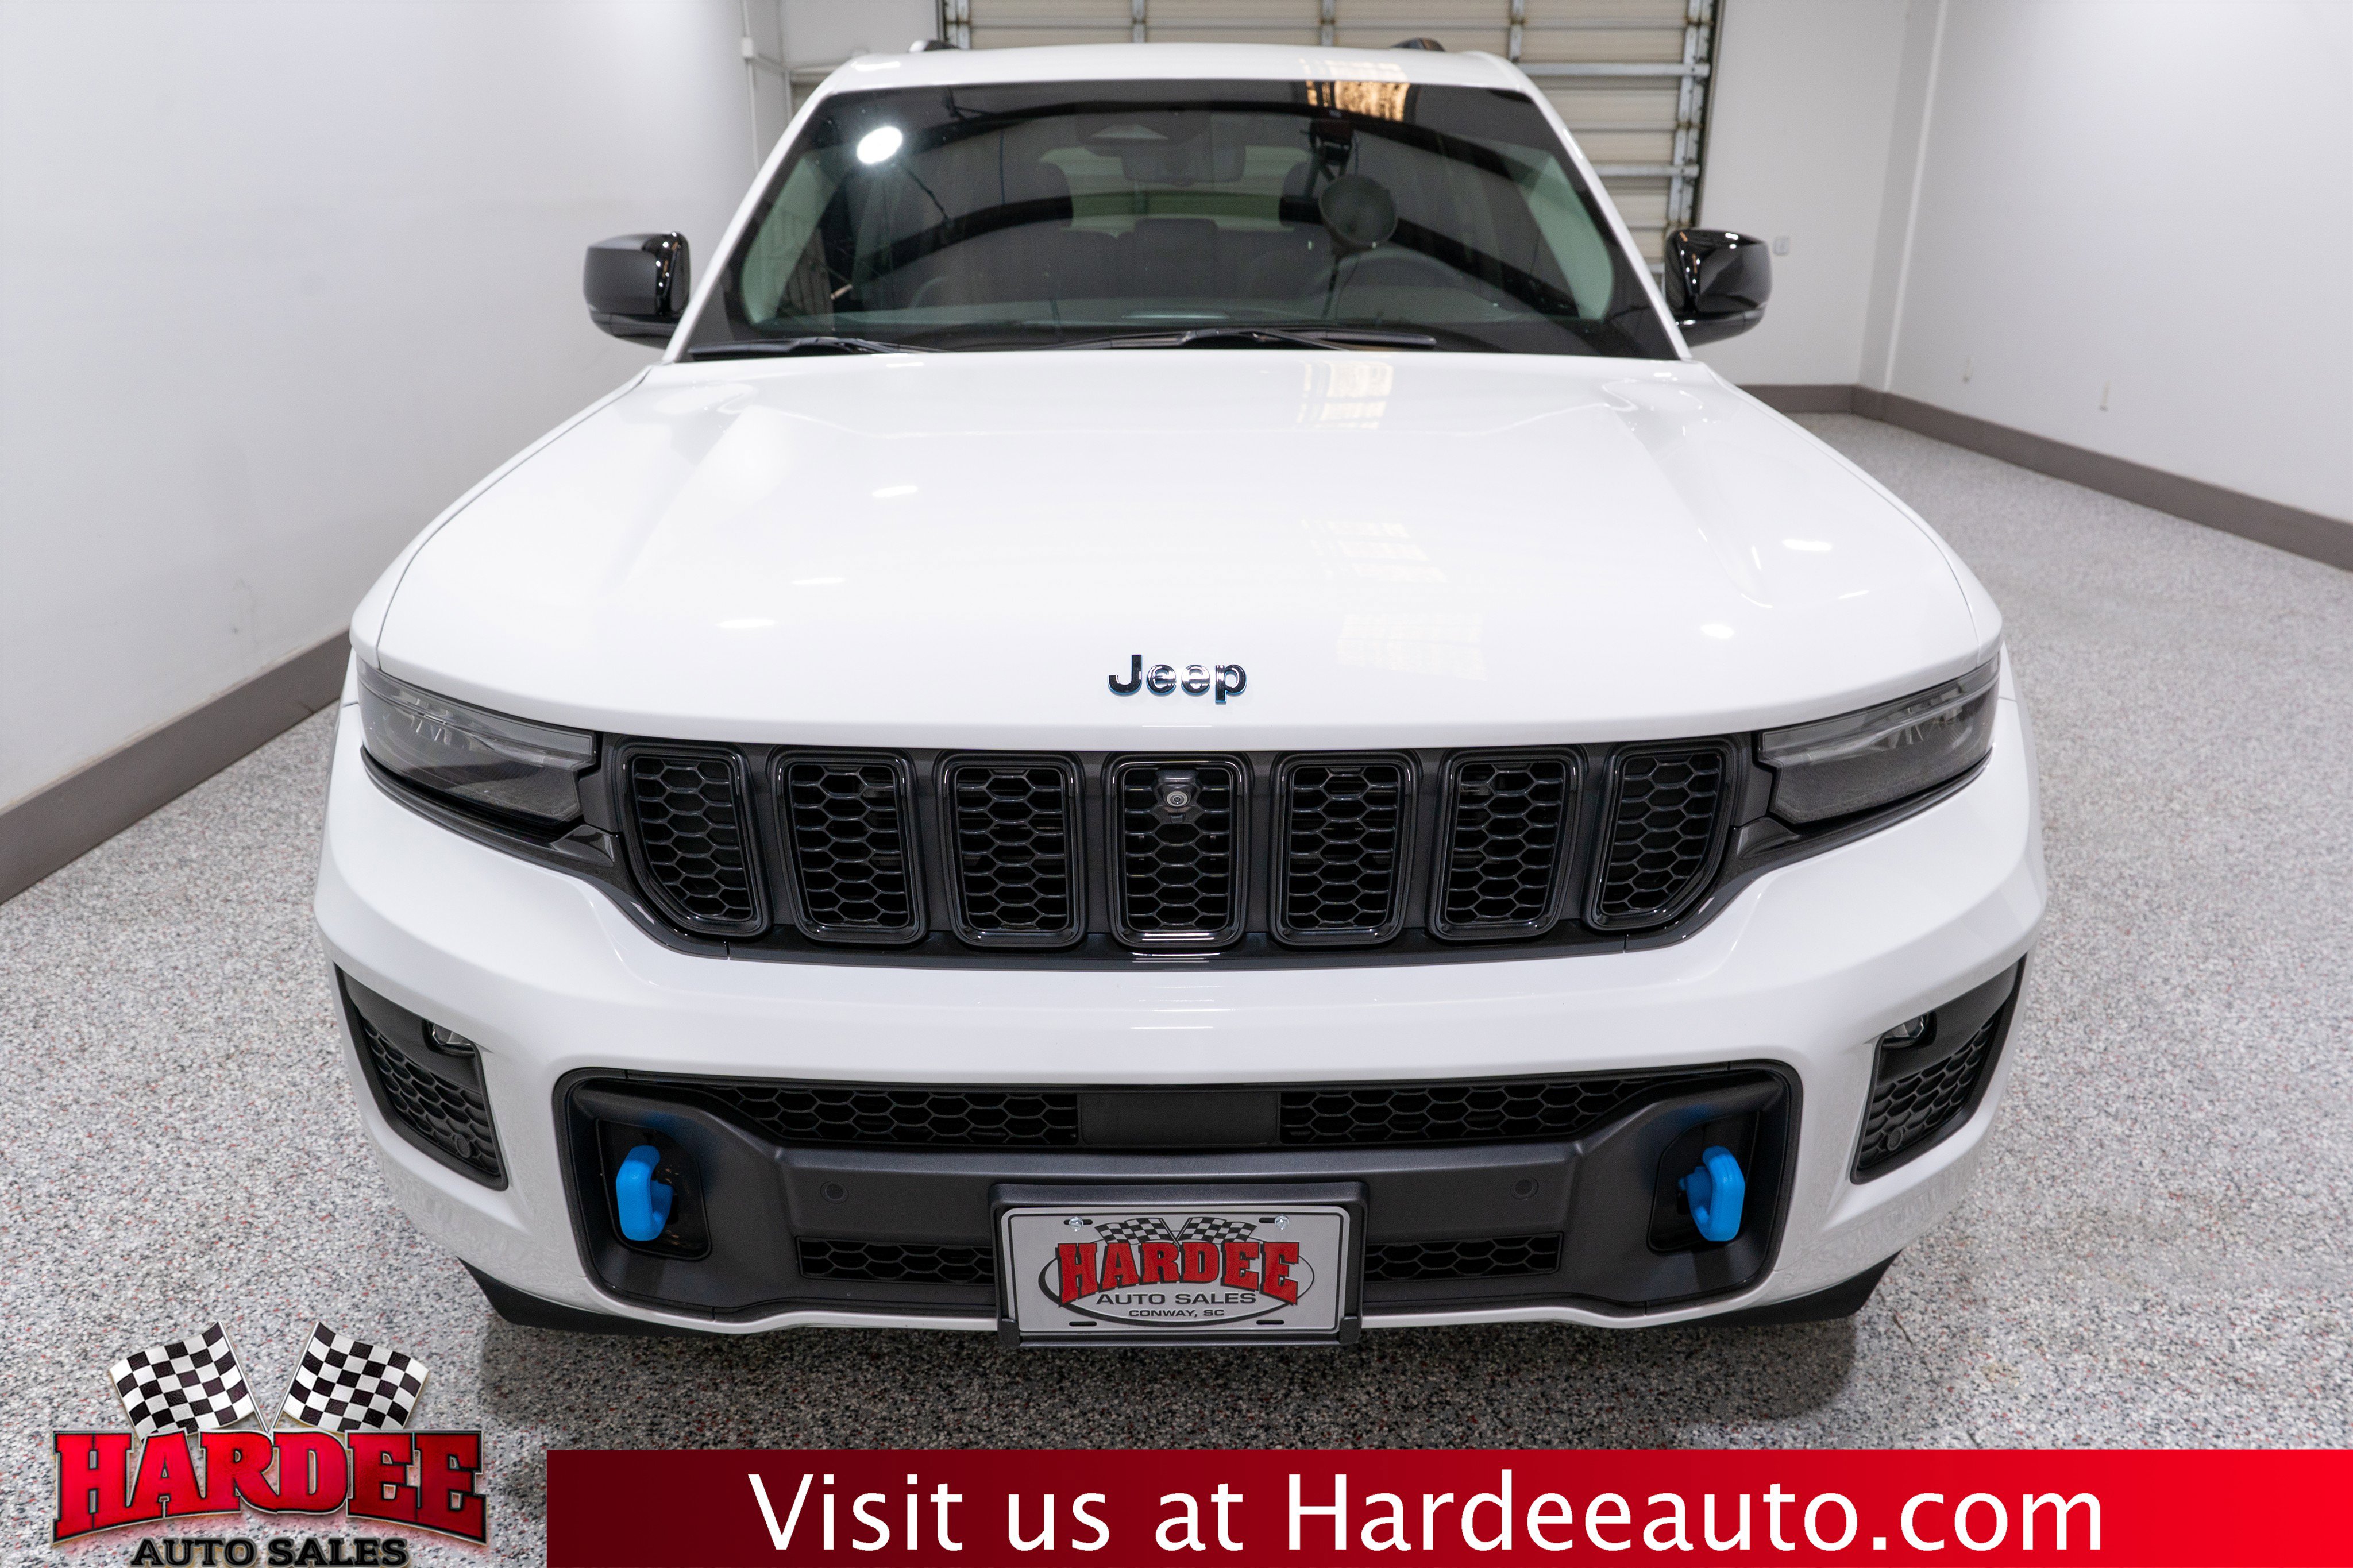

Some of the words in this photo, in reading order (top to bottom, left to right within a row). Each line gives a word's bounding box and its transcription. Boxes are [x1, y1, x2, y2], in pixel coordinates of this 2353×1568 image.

[1108, 654, 1247, 704] Jeep
[1056, 1241, 1300, 1307] HARDEE
[1096, 1293, 1166, 1306] AUTO
[1175, 1292, 1256, 1305] SALES
[1128, 1309, 1198, 1318] CONWAY,
[1203, 1309, 1225, 1317] SC
